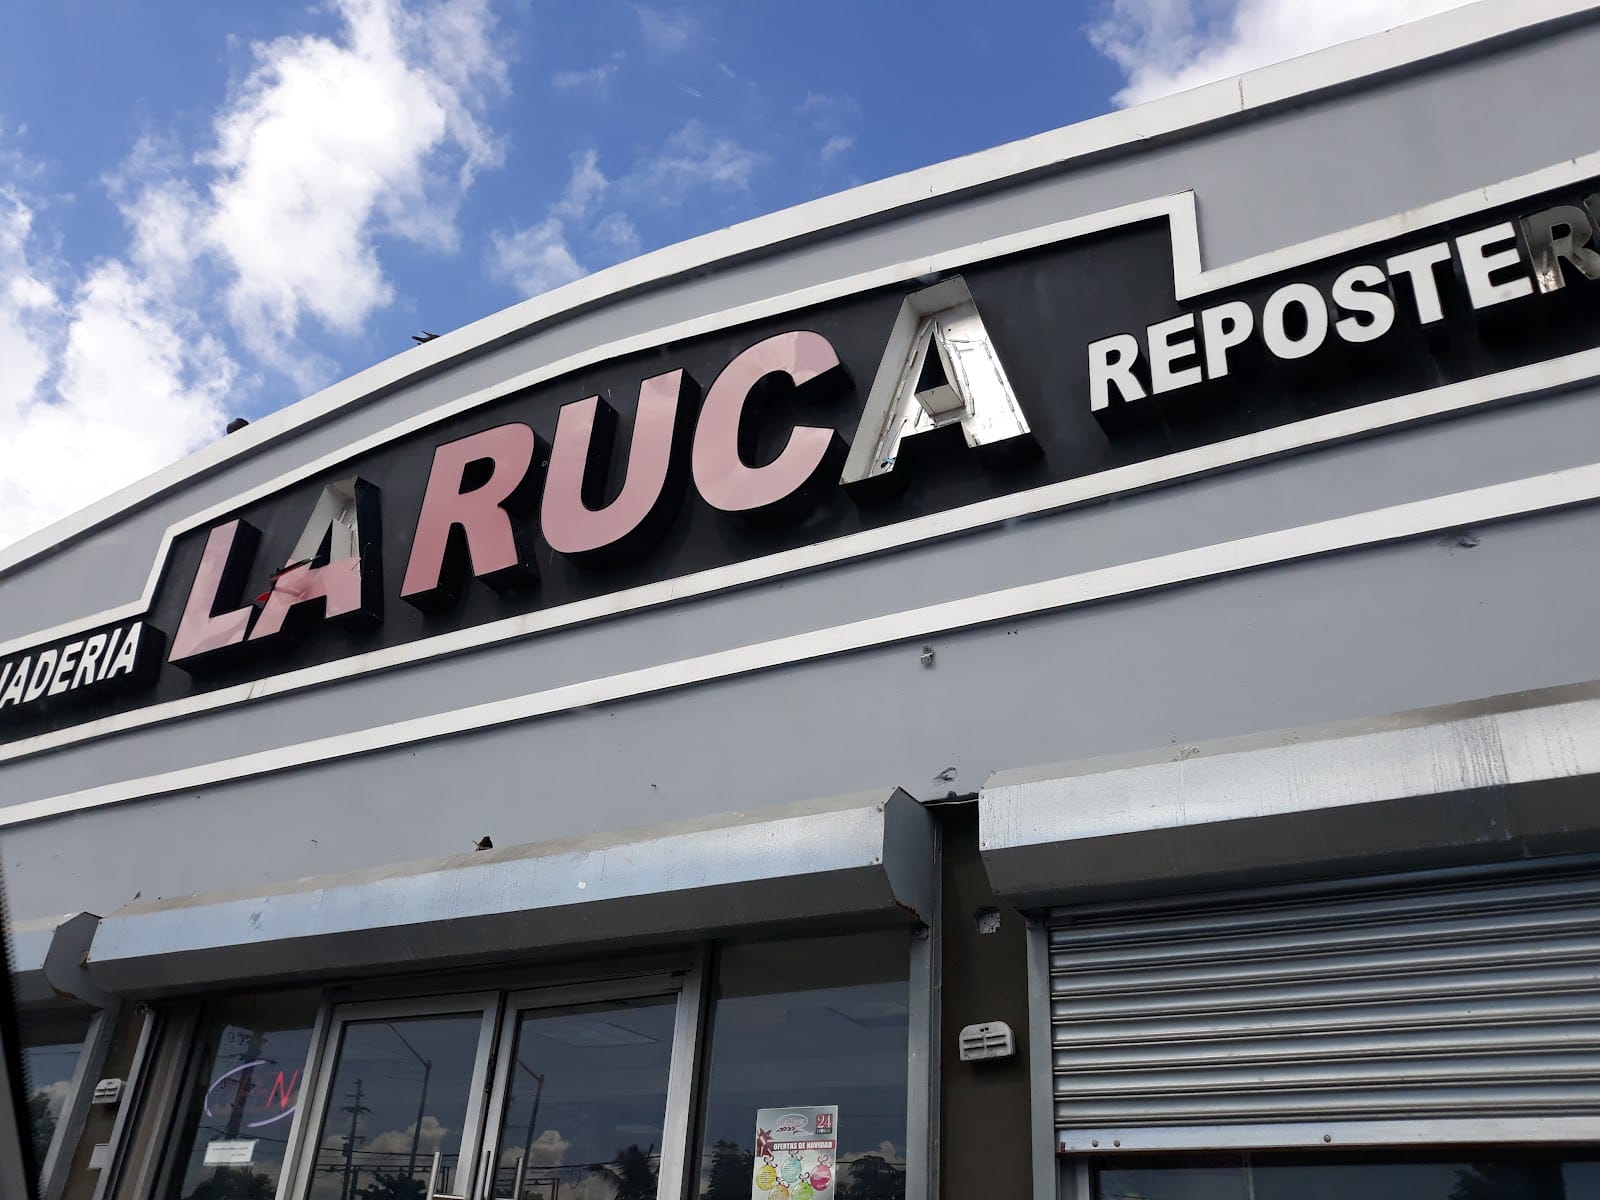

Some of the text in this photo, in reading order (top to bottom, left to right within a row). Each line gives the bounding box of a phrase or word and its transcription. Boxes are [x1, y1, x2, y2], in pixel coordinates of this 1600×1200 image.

[168, 274, 1032, 662] LA RUCA
[773, 1142, 798, 1150] OFERTAS
[806, 1141, 832, 1149] NAVIDAD
